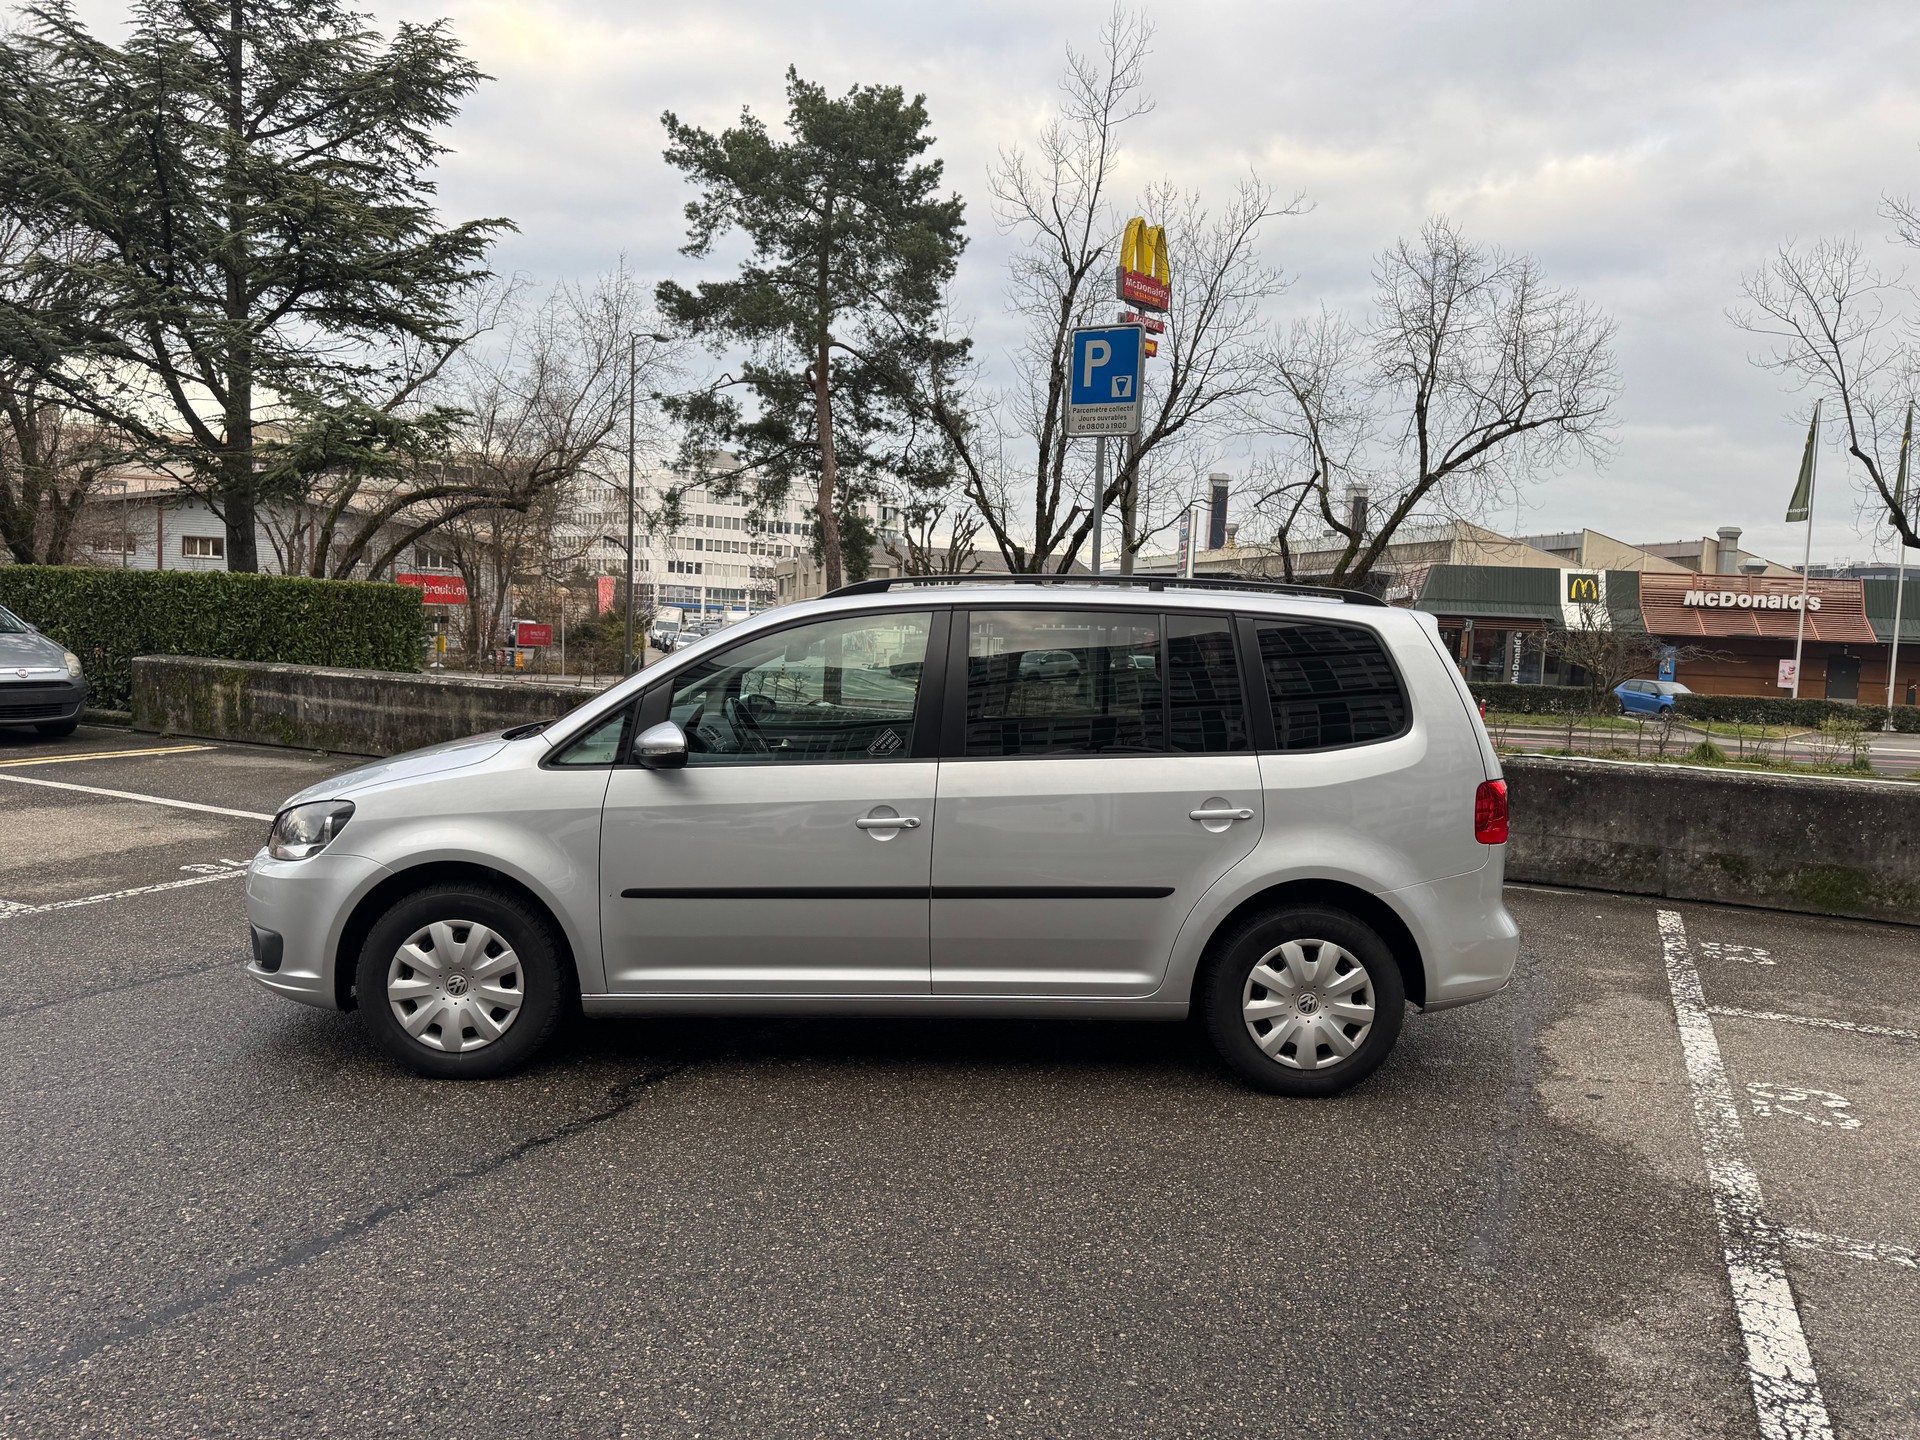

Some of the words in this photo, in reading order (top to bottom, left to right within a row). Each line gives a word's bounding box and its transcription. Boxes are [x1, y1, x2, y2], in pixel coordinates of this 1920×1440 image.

[1126, 278, 1168, 300] McDonald's
[1083, 339, 1112, 387] P
[1073, 406, 1107, 414] Parcomètre
[1683, 590, 1821, 611] McDonald's
[1511, 632, 1522, 684] McDonald's
